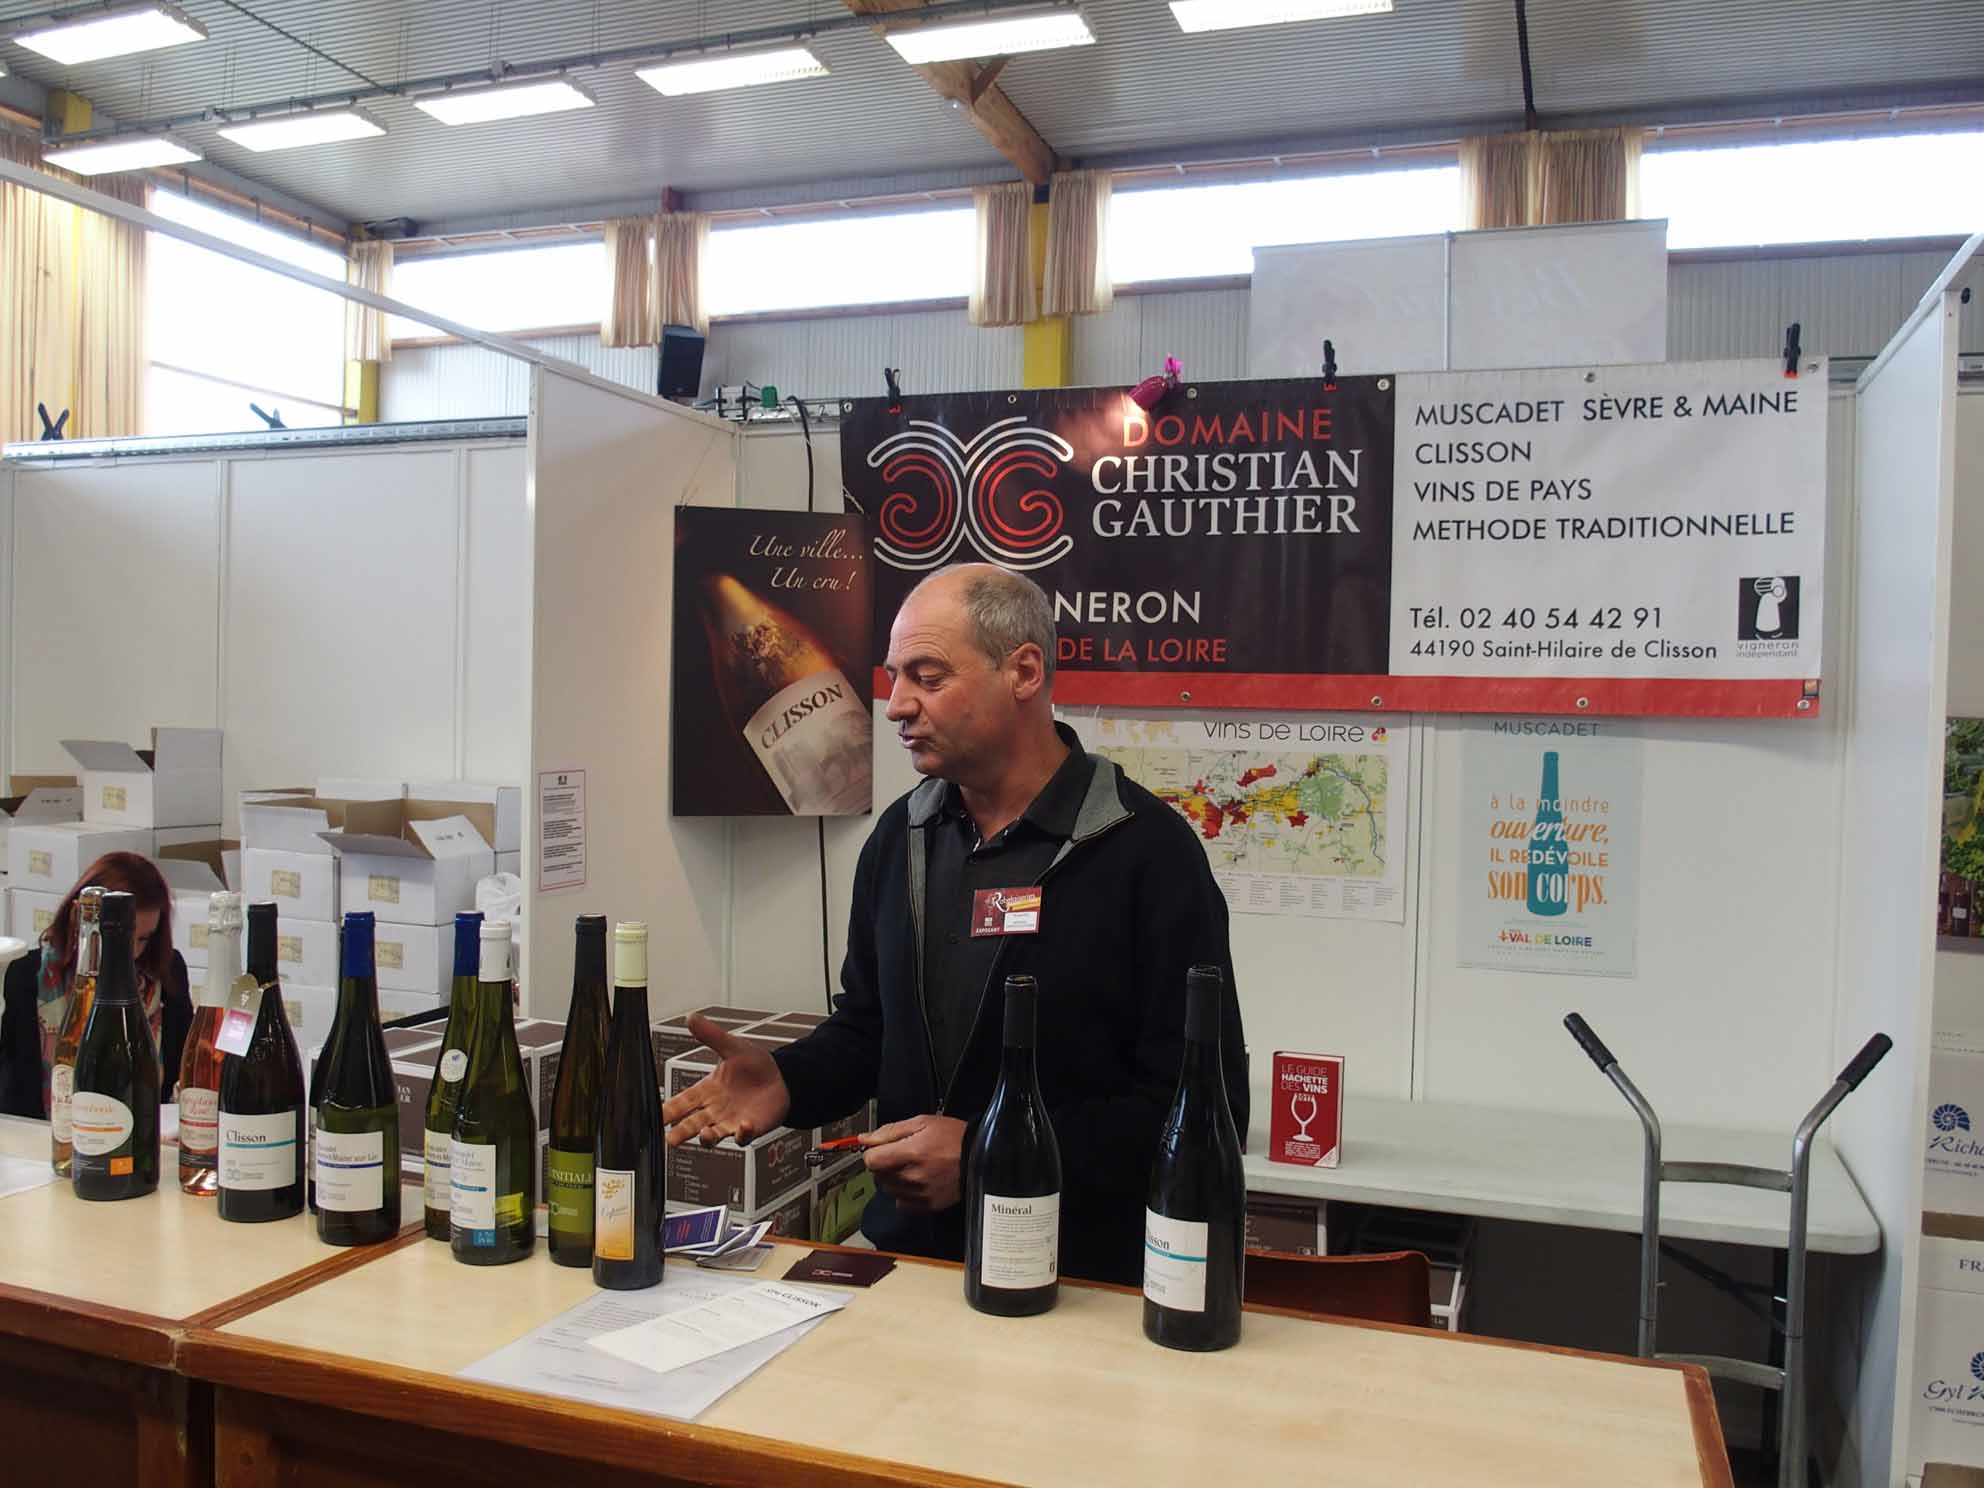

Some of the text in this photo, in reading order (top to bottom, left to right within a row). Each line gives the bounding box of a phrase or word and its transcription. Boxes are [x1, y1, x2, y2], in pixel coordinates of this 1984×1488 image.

[1414, 391, 1799, 425] MUSCADET SÈVRE & MAINE
[1123, 408, 1333, 448] DOMAINE
[1415, 441, 1532, 465] CLISSON
[1091, 449, 1363, 495] CHRISTIAN
[1413, 478, 1593, 503] VINS DE PAYS
[1091, 495, 1361, 537] GAUTHIER
[1412, 511, 1795, 541] METHODE TRADITIONNELLE
[749, 535, 793, 557] Une
[770, 567, 807, 588] Un
[1053, 590, 1201, 624] NERON
[1409, 607, 1663, 630] Tél. 02 40 54 42 91
[1057, 639, 1228, 664] DE LA LOIRE
[1409, 639, 1718, 660] 44190 Saint-Hilaire de Clisson
[1736, 642, 1800, 652] vigneron
[761, 683, 845, 749] CLISSON
[1493, 721, 1601, 737] MUSCADET
[1509, 793, 1526, 811] la
[1535, 795, 1609, 815] moindre
[1488, 815, 1609, 846] ouverture,
[1490, 847, 1505, 863] IL
[1487, 869, 1609, 913] son corps.
[1509, 932, 1532, 944] VAL
[1554, 935, 1593, 947] LOIRE
[1281, 1063, 1295, 1074] LE
[1281, 1073, 1329, 1085] HACHETTE
[1302, 1083, 1328, 1094] VINS
[226, 1129, 266, 1143] Clisson
[991, 1203, 1032, 1215] Minéral
